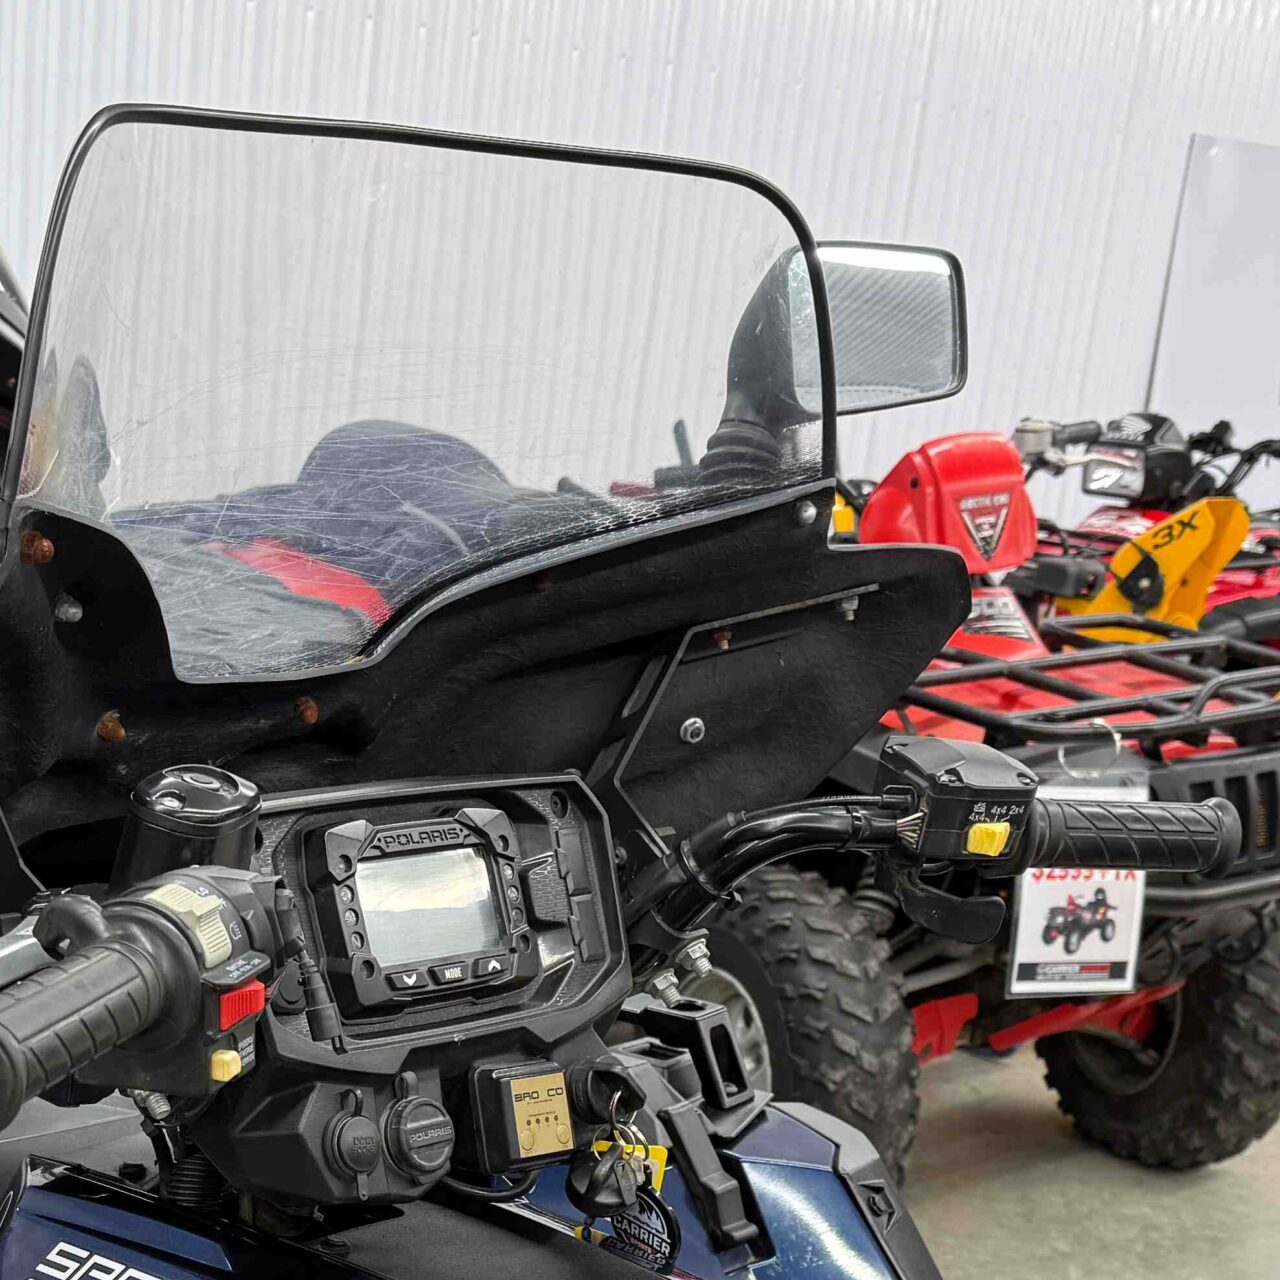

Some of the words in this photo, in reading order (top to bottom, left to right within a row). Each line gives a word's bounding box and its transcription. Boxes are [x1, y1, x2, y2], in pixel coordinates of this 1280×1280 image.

[383, 826, 461, 848] POLARIS
[445, 967, 462, 980] MODE
[613, 1215, 671, 1257] CARRIER
